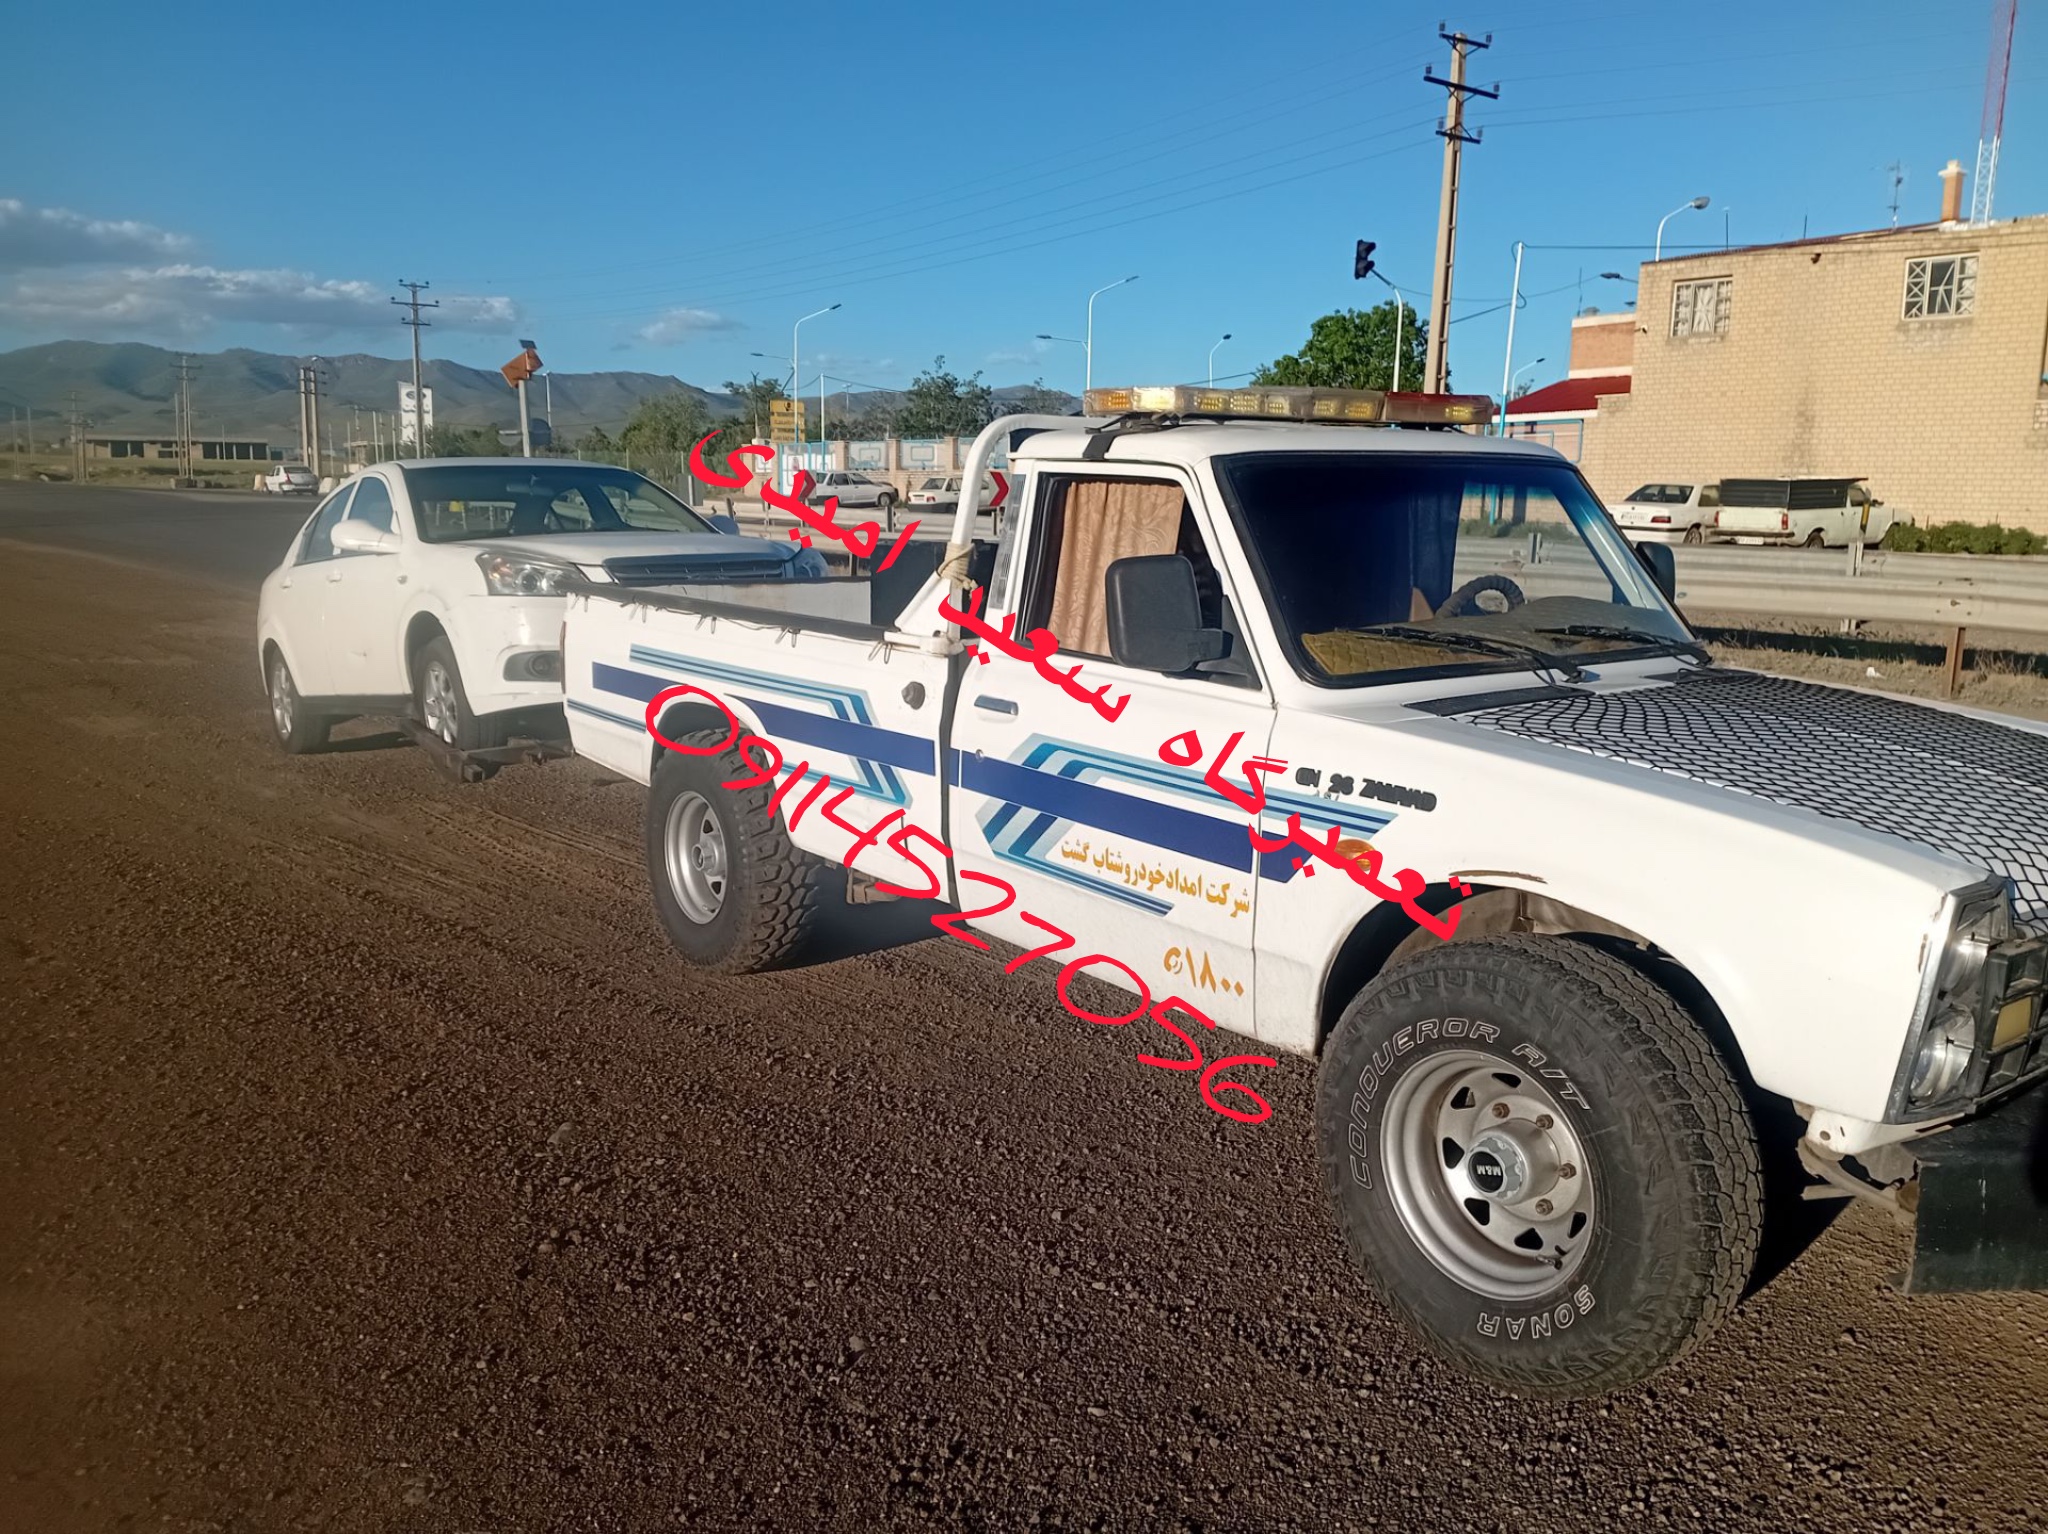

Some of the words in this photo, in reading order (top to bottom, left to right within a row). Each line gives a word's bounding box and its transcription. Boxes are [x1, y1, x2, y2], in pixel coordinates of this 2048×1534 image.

[1205, 882, 1250, 918] شرکت
[1348, 1018, 1500, 1190] CONQUEROR
[1512, 1043, 1592, 1111] A/T
[1476, 1164, 1502, 1177] M&M
[1477, 1284, 1596, 1340] SONAR
